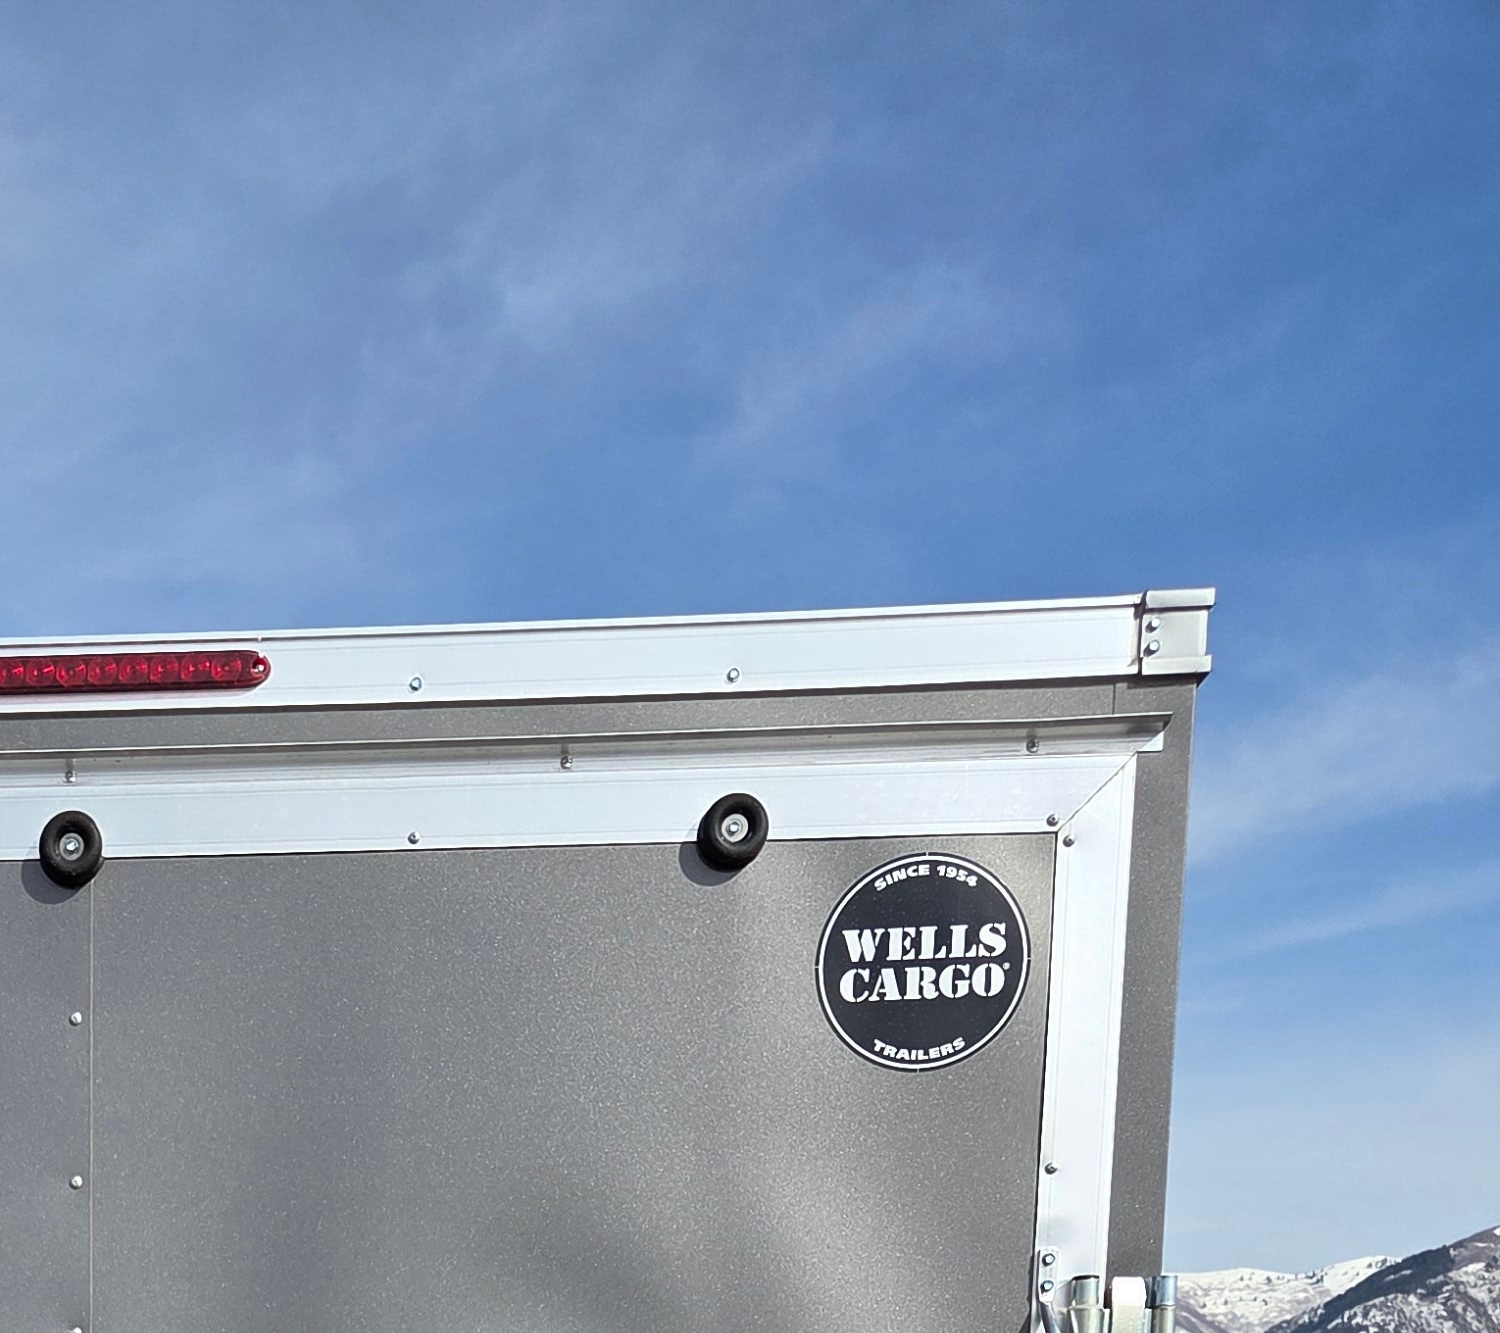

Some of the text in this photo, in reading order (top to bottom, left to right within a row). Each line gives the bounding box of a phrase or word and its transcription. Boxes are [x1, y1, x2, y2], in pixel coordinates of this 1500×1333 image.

[874, 864, 978, 892] SINCE 1954
[842, 922, 1007, 963] WELLS
[839, 963, 1006, 1003] CARGO
[873, 1037, 966, 1061] TRAILERS
